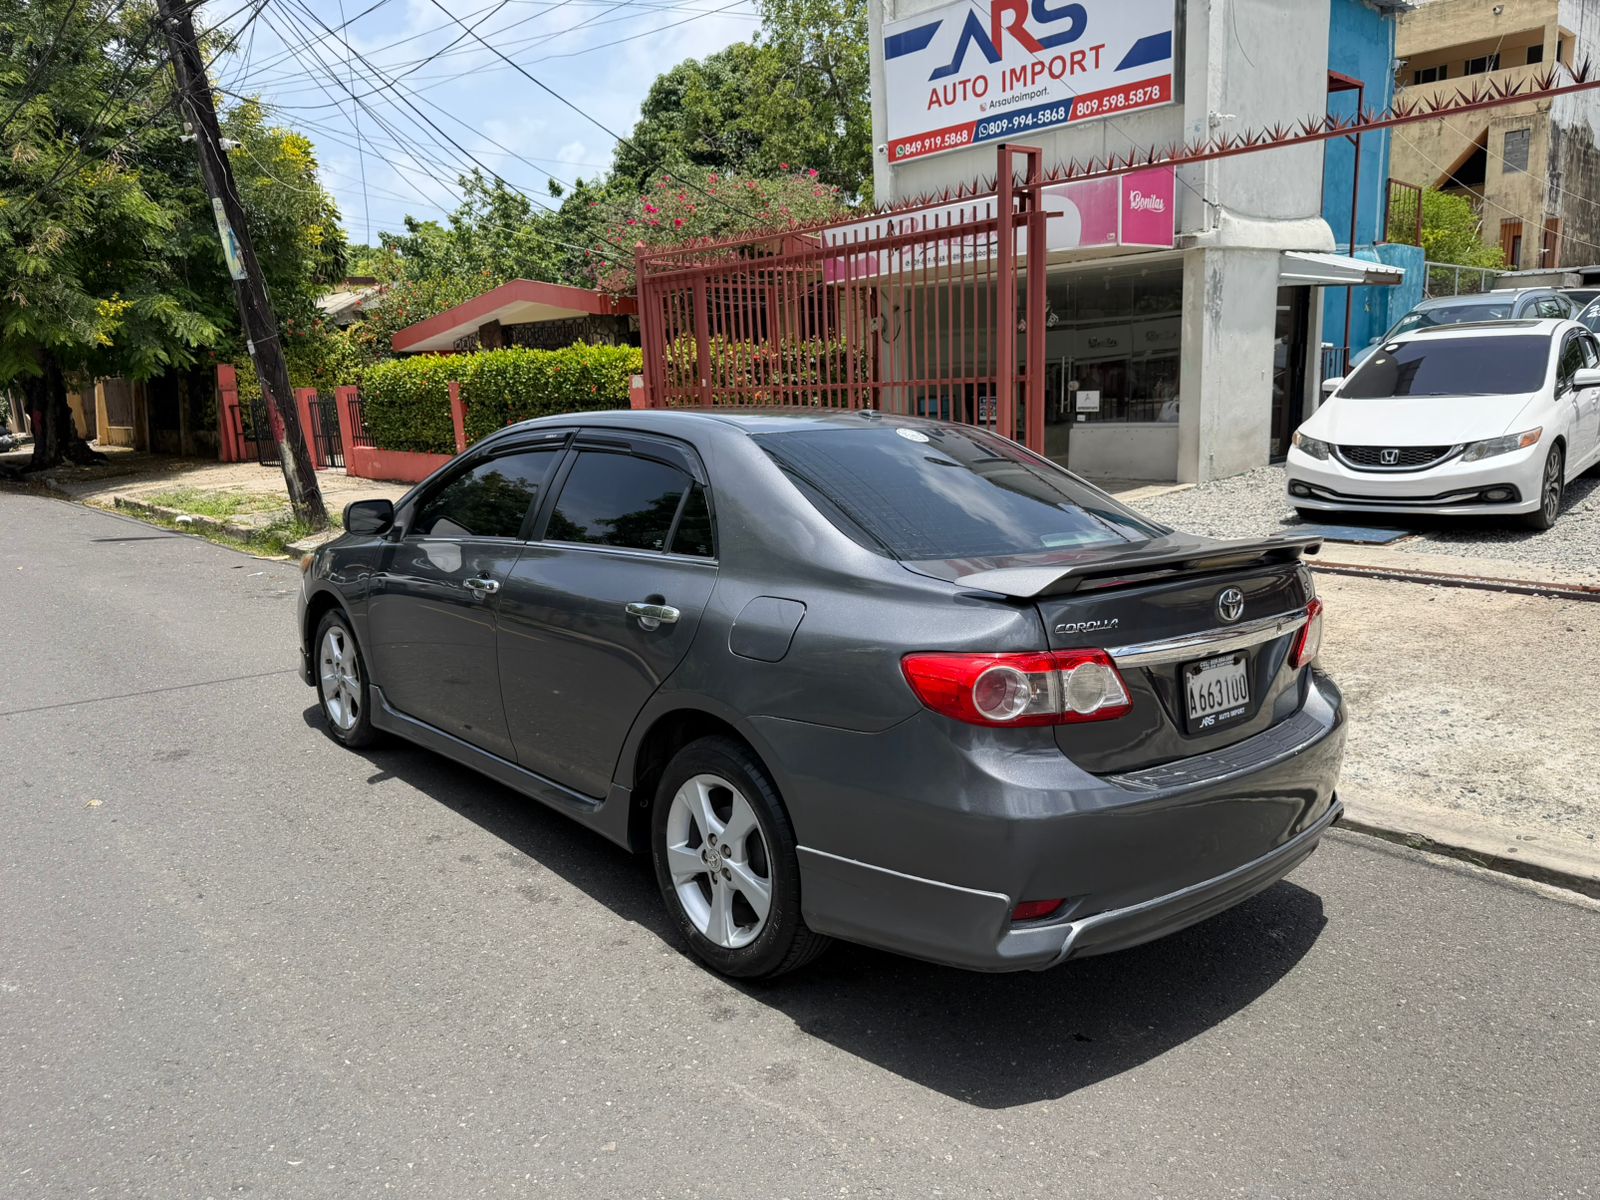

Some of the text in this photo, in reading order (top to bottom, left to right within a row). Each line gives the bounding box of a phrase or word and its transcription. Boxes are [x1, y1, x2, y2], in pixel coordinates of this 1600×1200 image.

[928, 0, 1088, 81] ARS
[927, 43, 1106, 111] AUTO IMPORT
[903, 130, 968, 156] 849.919.5868
[988, 105, 1065, 136] 809-994-5868
[1076, 85, 1160, 116] 809.598.5878
[1129, 189, 1166, 213] Bonitas
[1054, 618, 1119, 635] COROLLA
[1190, 673, 1248, 716] A663100
